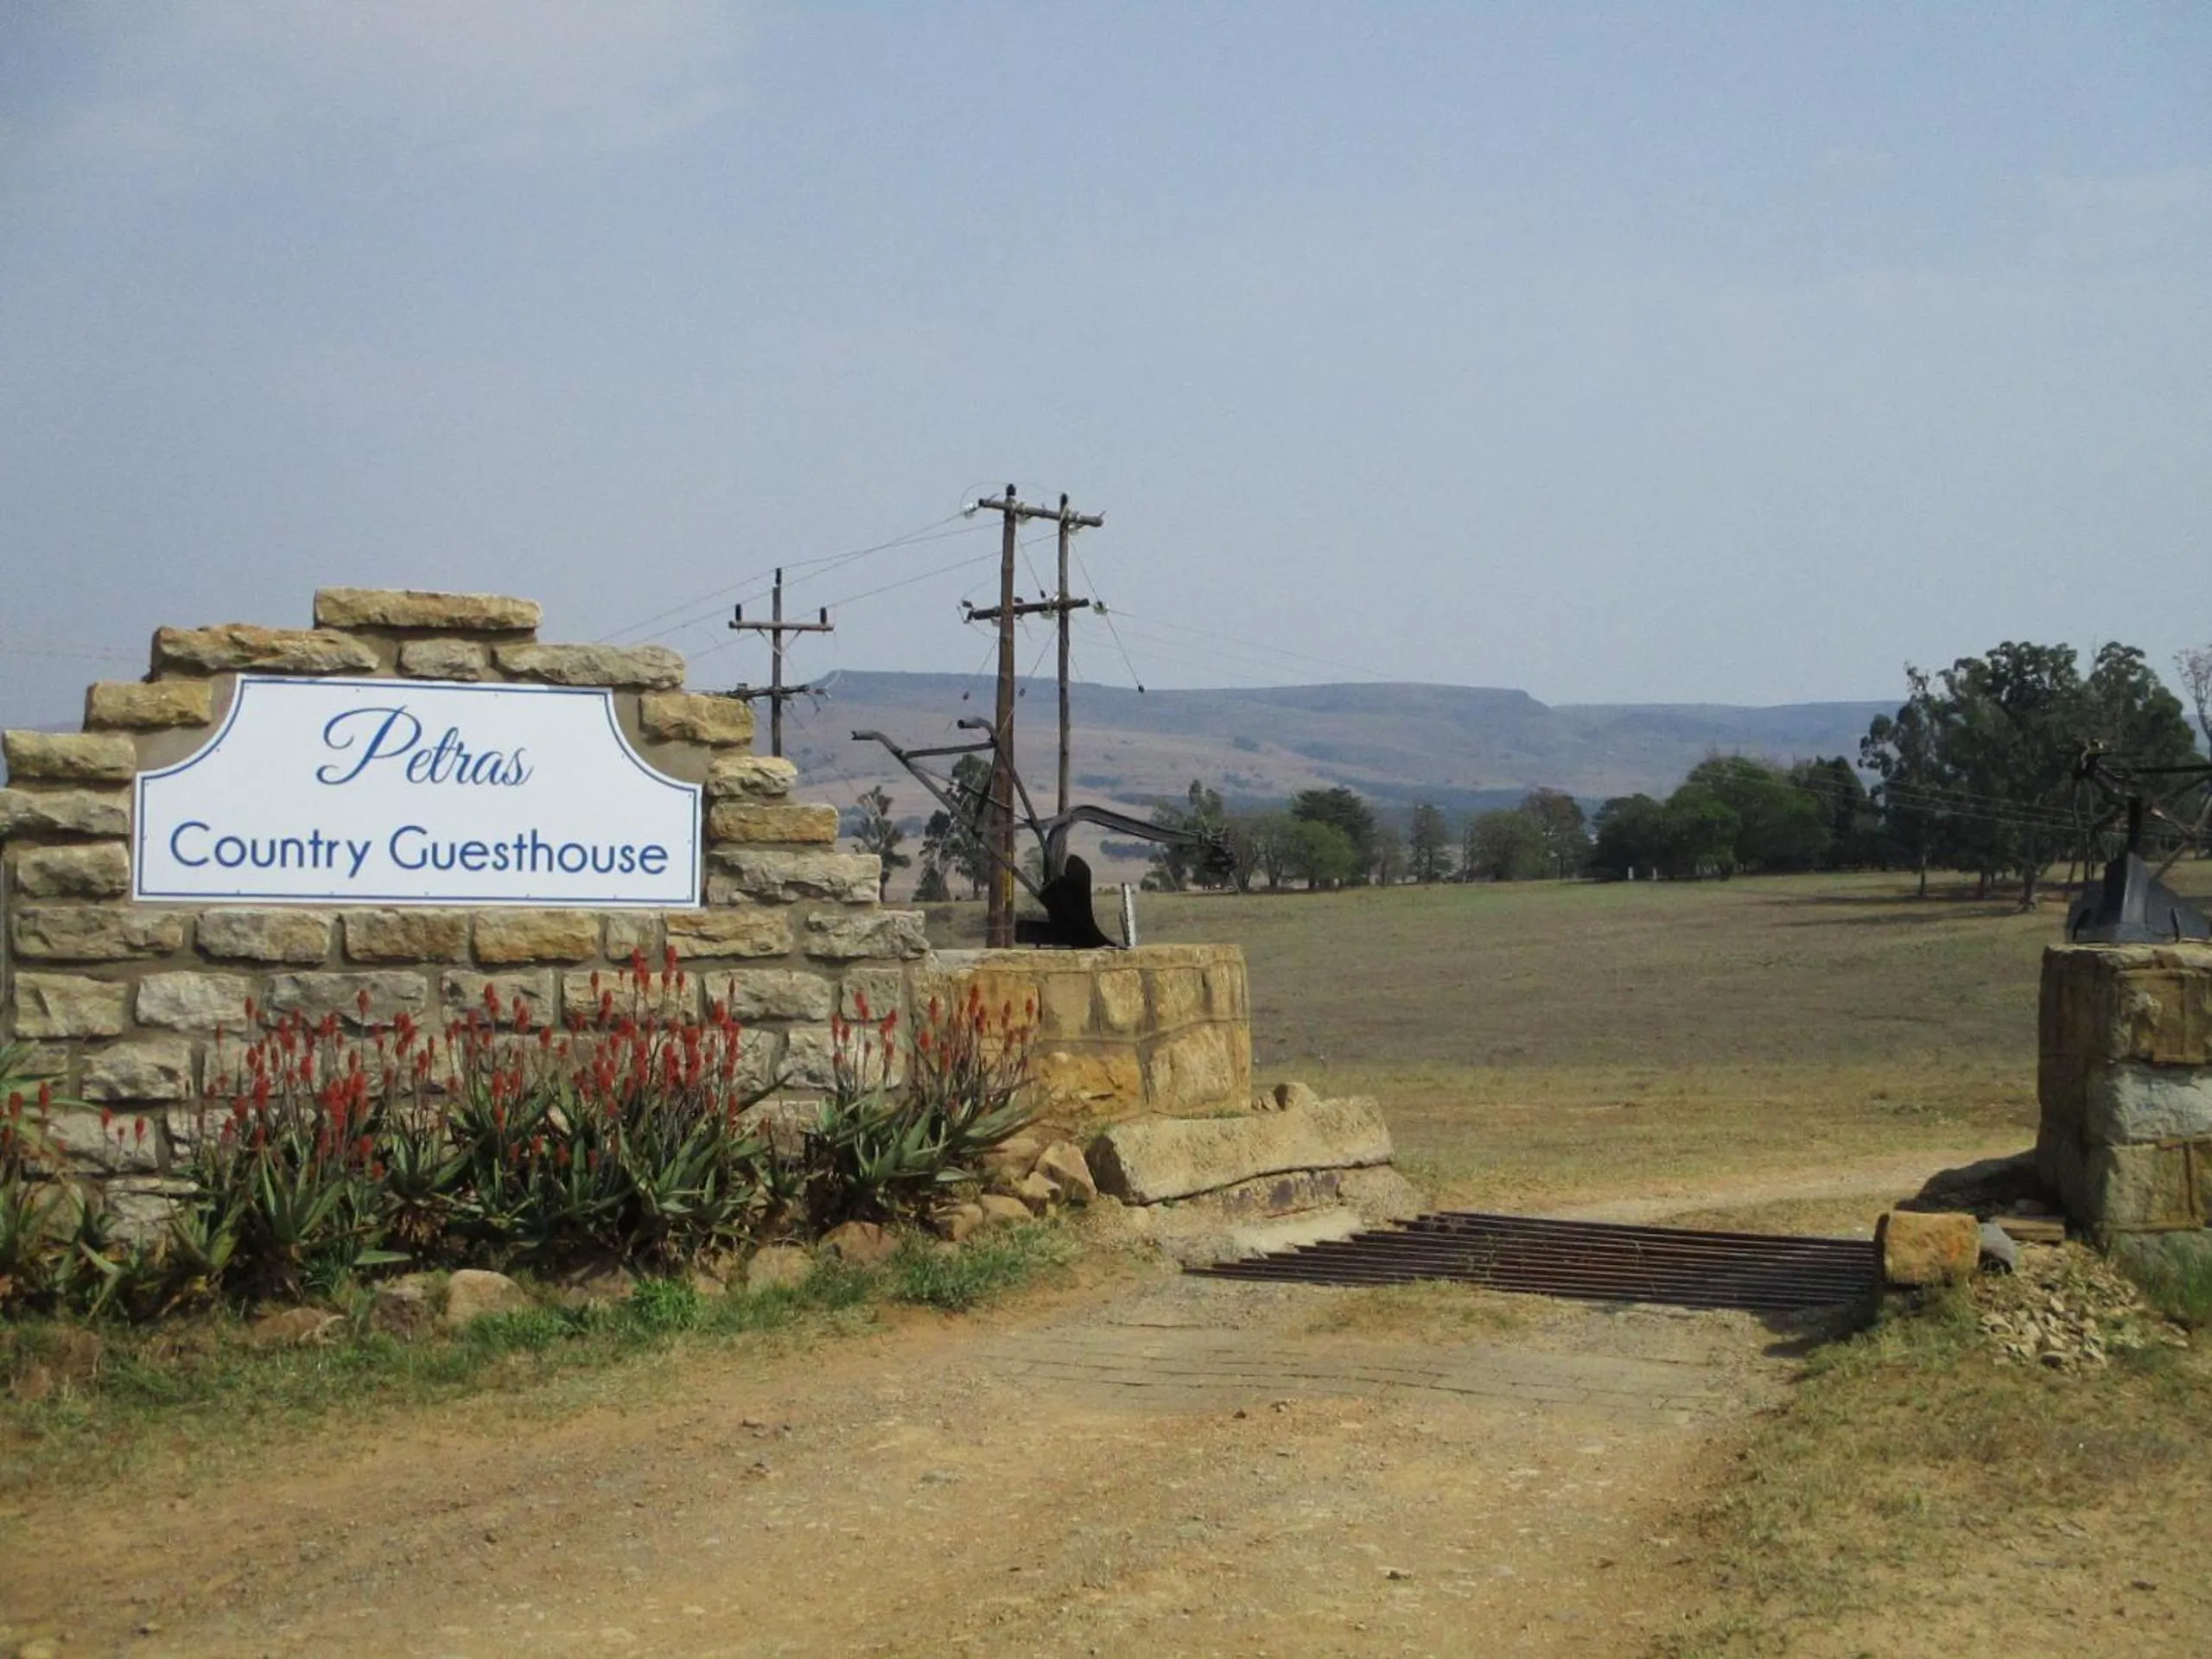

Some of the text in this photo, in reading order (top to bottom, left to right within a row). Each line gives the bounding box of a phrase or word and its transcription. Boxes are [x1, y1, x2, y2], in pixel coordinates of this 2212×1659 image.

[316, 705, 533, 786] Petras
[170, 821, 669, 878] Country Guesthouse
